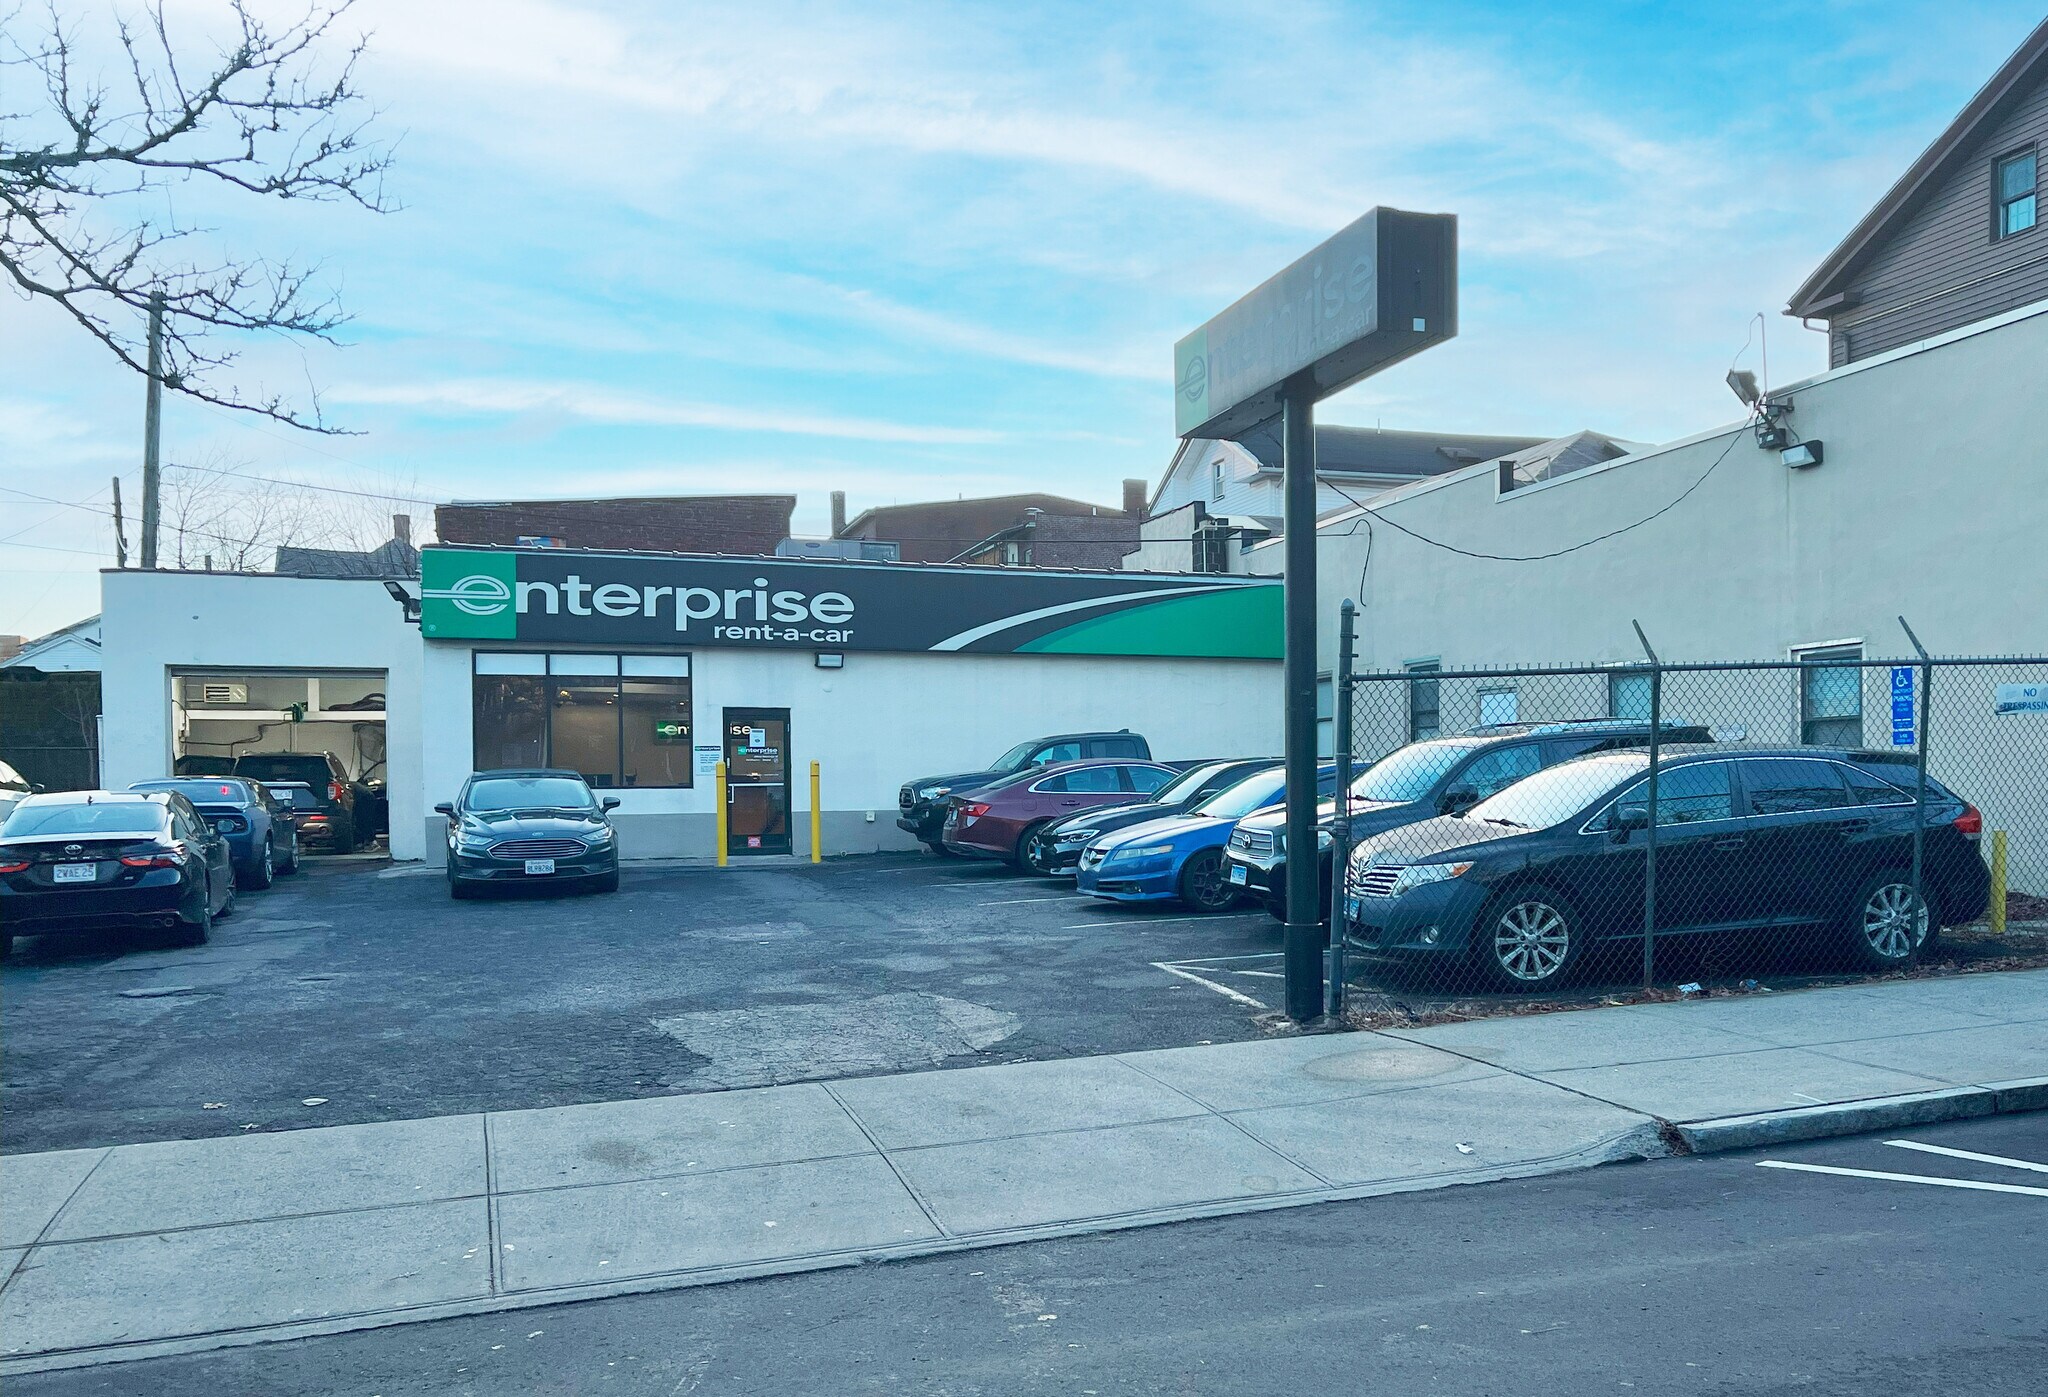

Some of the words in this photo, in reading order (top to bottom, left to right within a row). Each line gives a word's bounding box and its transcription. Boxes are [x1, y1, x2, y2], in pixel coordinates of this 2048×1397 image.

[426, 572, 856, 632] enterprise
[713, 622, 854, 644] rent-a-car
[2023, 687, 2037, 697] NO
[740, 746, 778, 755] enterprise
